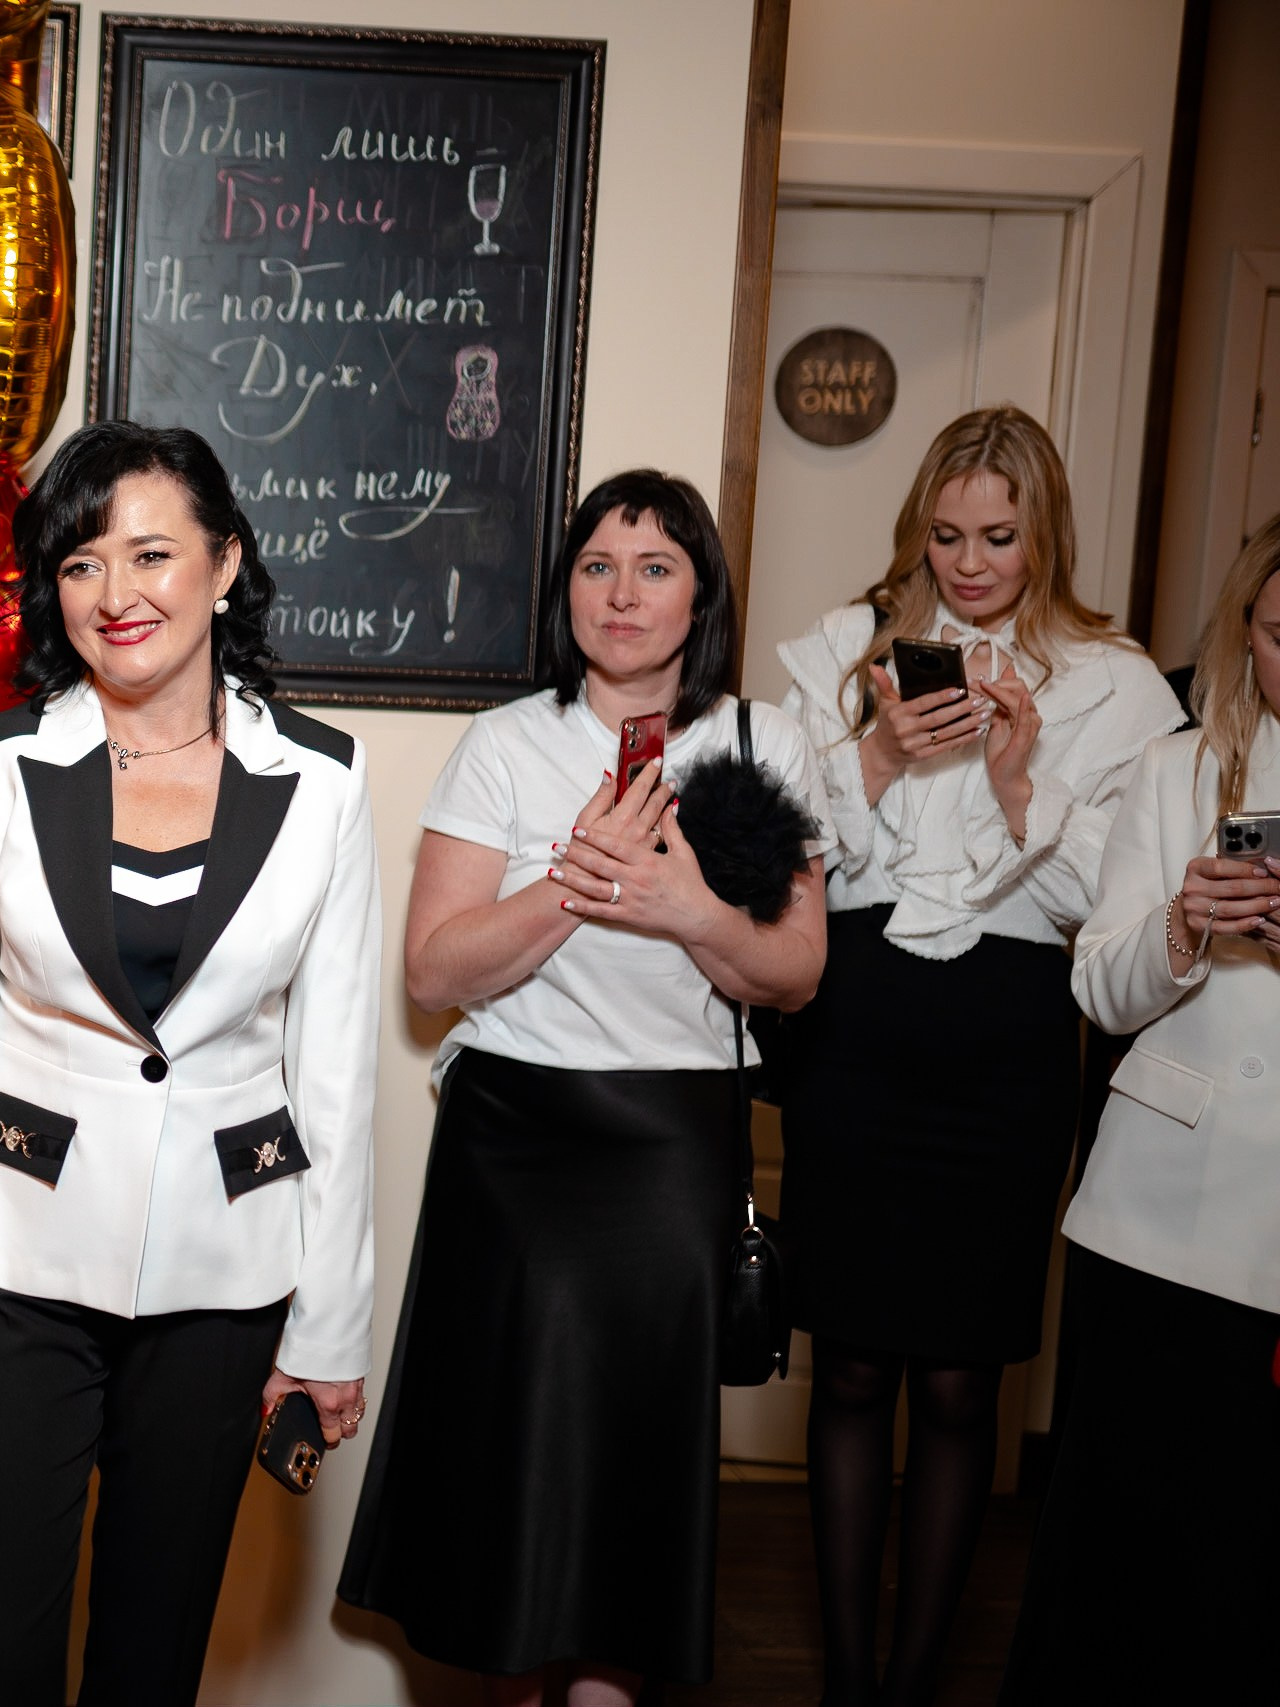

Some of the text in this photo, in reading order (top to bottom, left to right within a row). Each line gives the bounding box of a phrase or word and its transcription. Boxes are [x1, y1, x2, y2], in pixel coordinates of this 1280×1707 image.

[158, 79, 460, 165] Один лишь
[216, 169, 397, 251] Борщ
[143, 255, 490, 326] Не поднимет
[799, 387, 876, 415] ONLY
[800, 359, 876, 386] STAFF
[253, 516, 330, 565] щё
